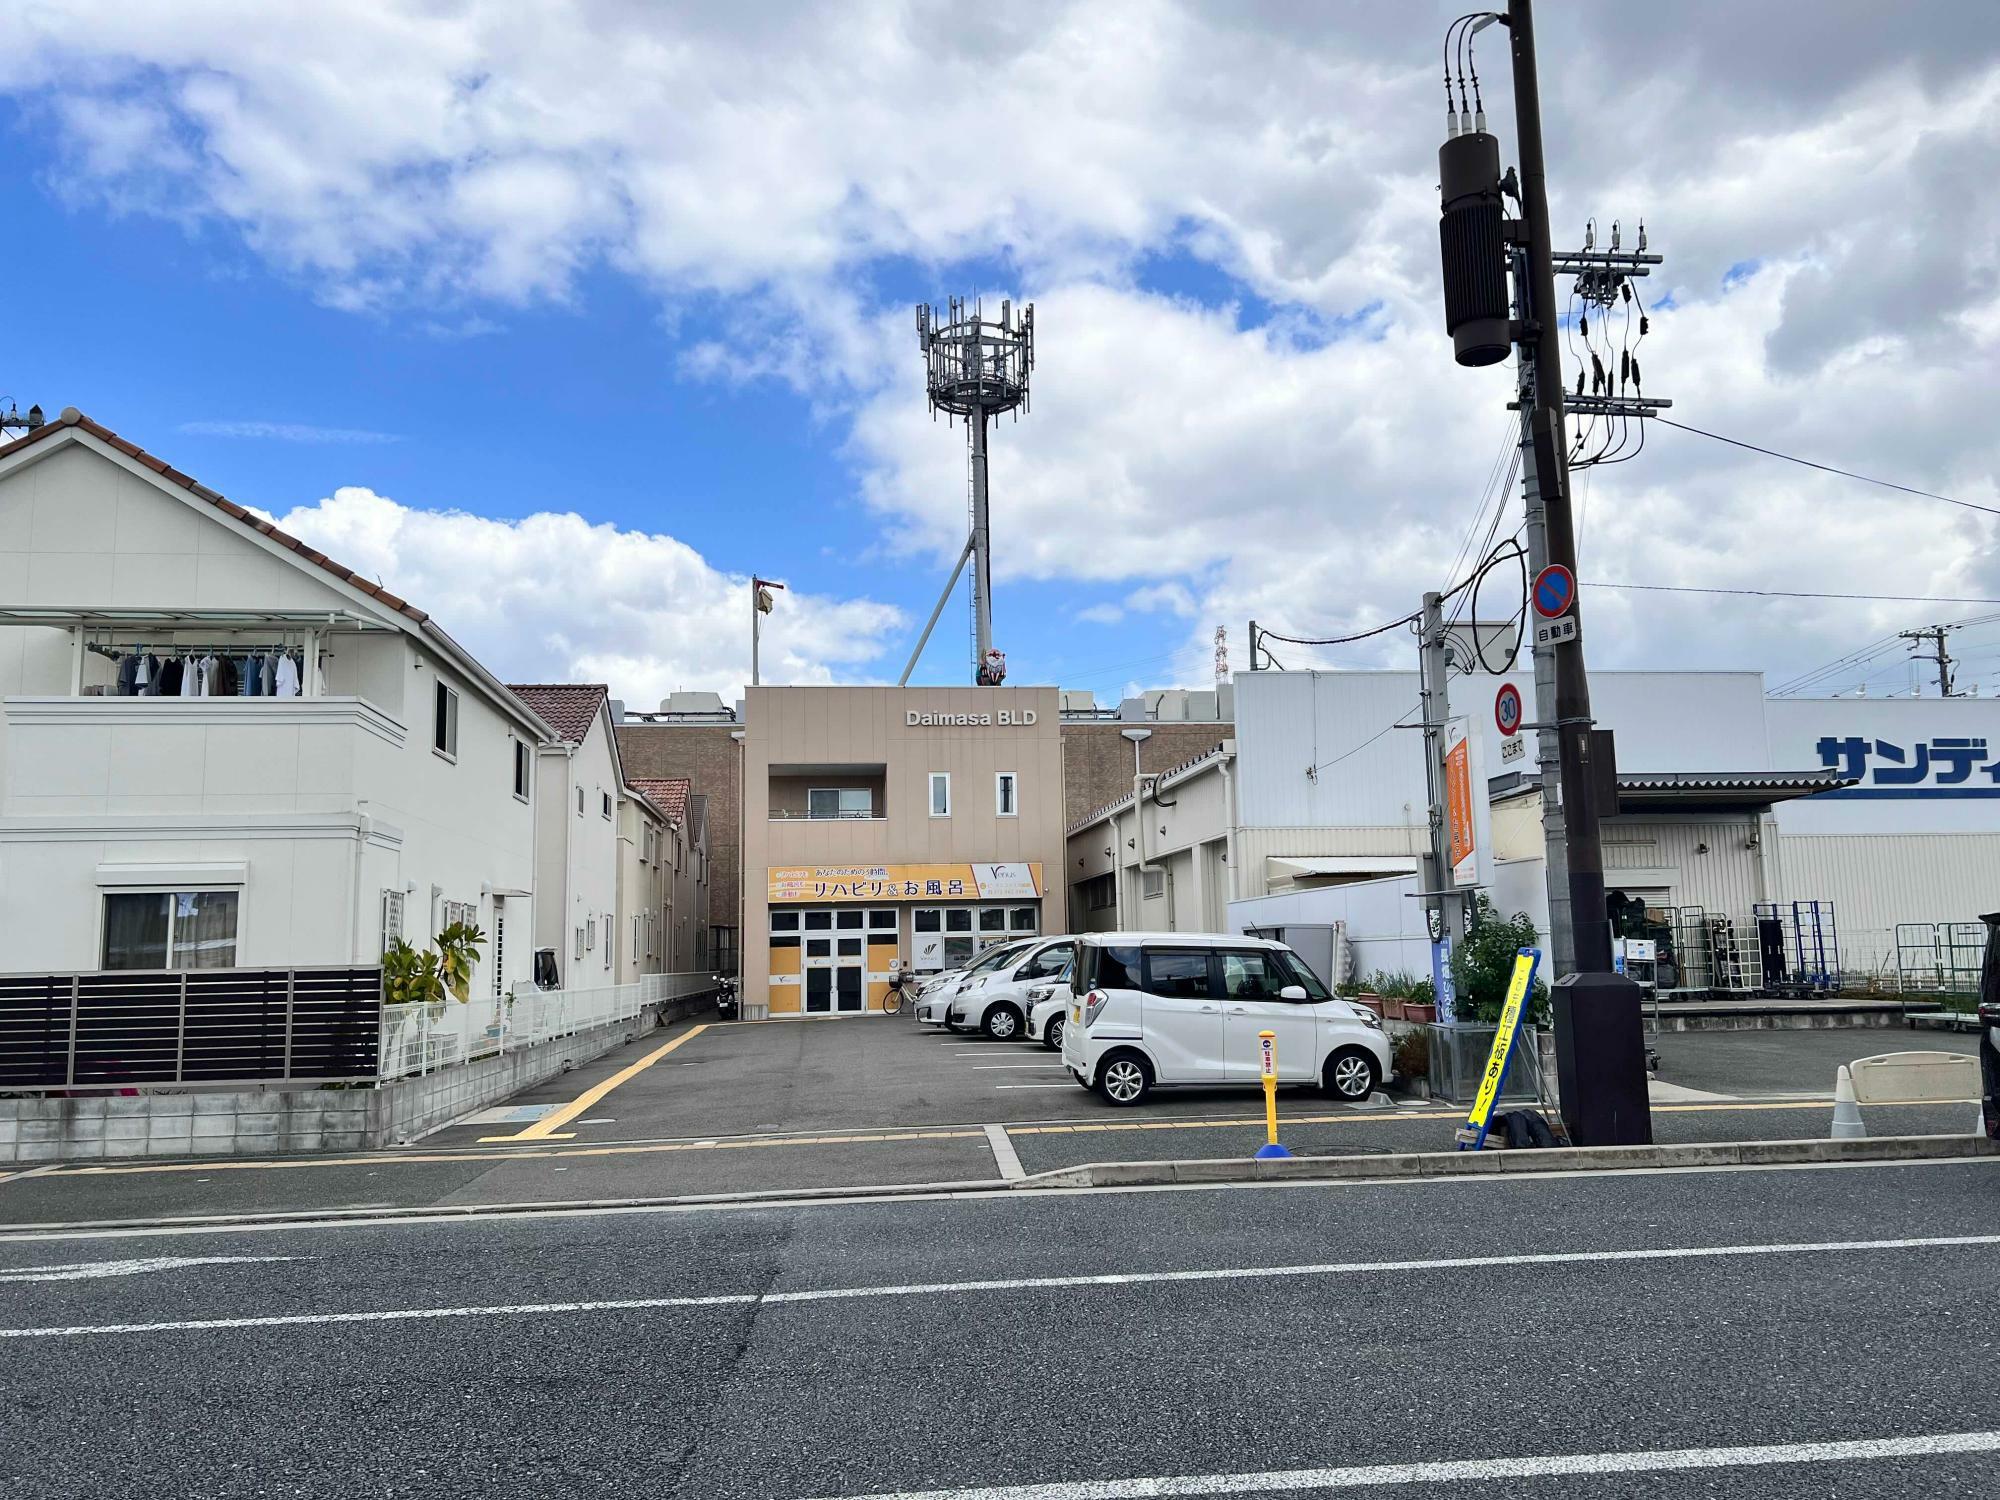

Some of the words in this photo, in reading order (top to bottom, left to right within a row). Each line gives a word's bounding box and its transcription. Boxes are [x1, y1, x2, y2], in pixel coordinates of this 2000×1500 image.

[1538, 621, 1574, 642] 自動車
[906, 710, 992, 726] Daimasa
[996, 709, 1037, 726] BLD
[1500, 698, 1516, 723] 30
[1502, 739, 1523, 760] ここまで
